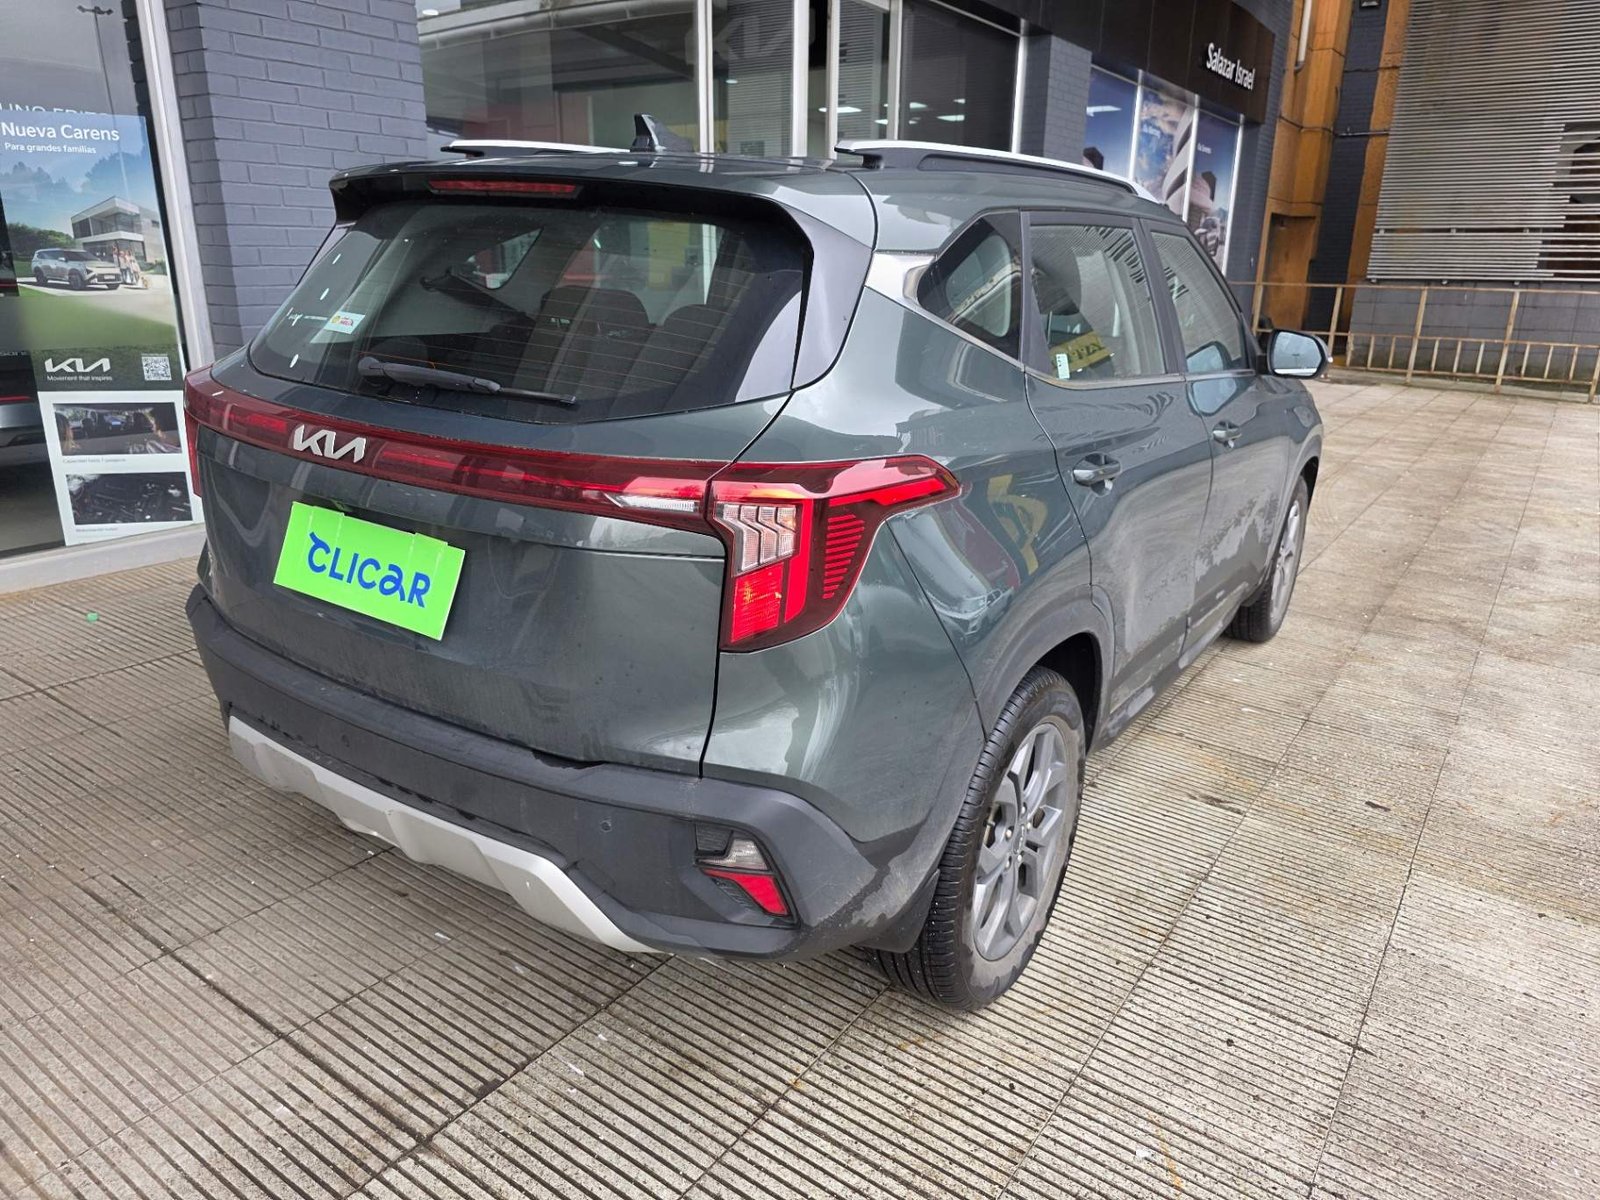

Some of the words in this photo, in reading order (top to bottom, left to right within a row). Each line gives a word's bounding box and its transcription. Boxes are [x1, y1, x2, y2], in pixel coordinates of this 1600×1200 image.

[1206, 42, 1236, 80] Salazar
[1235, 59, 1256, 91] Israel
[1, 122, 57, 138] Nueva
[60, 124, 120, 141] Carens
[4, 142, 25, 151] Para
[26, 143, 60, 152] grandes
[63, 144, 96, 154] familias
[44, 357, 111, 373] KIA
[292, 424, 367, 464] KIA
